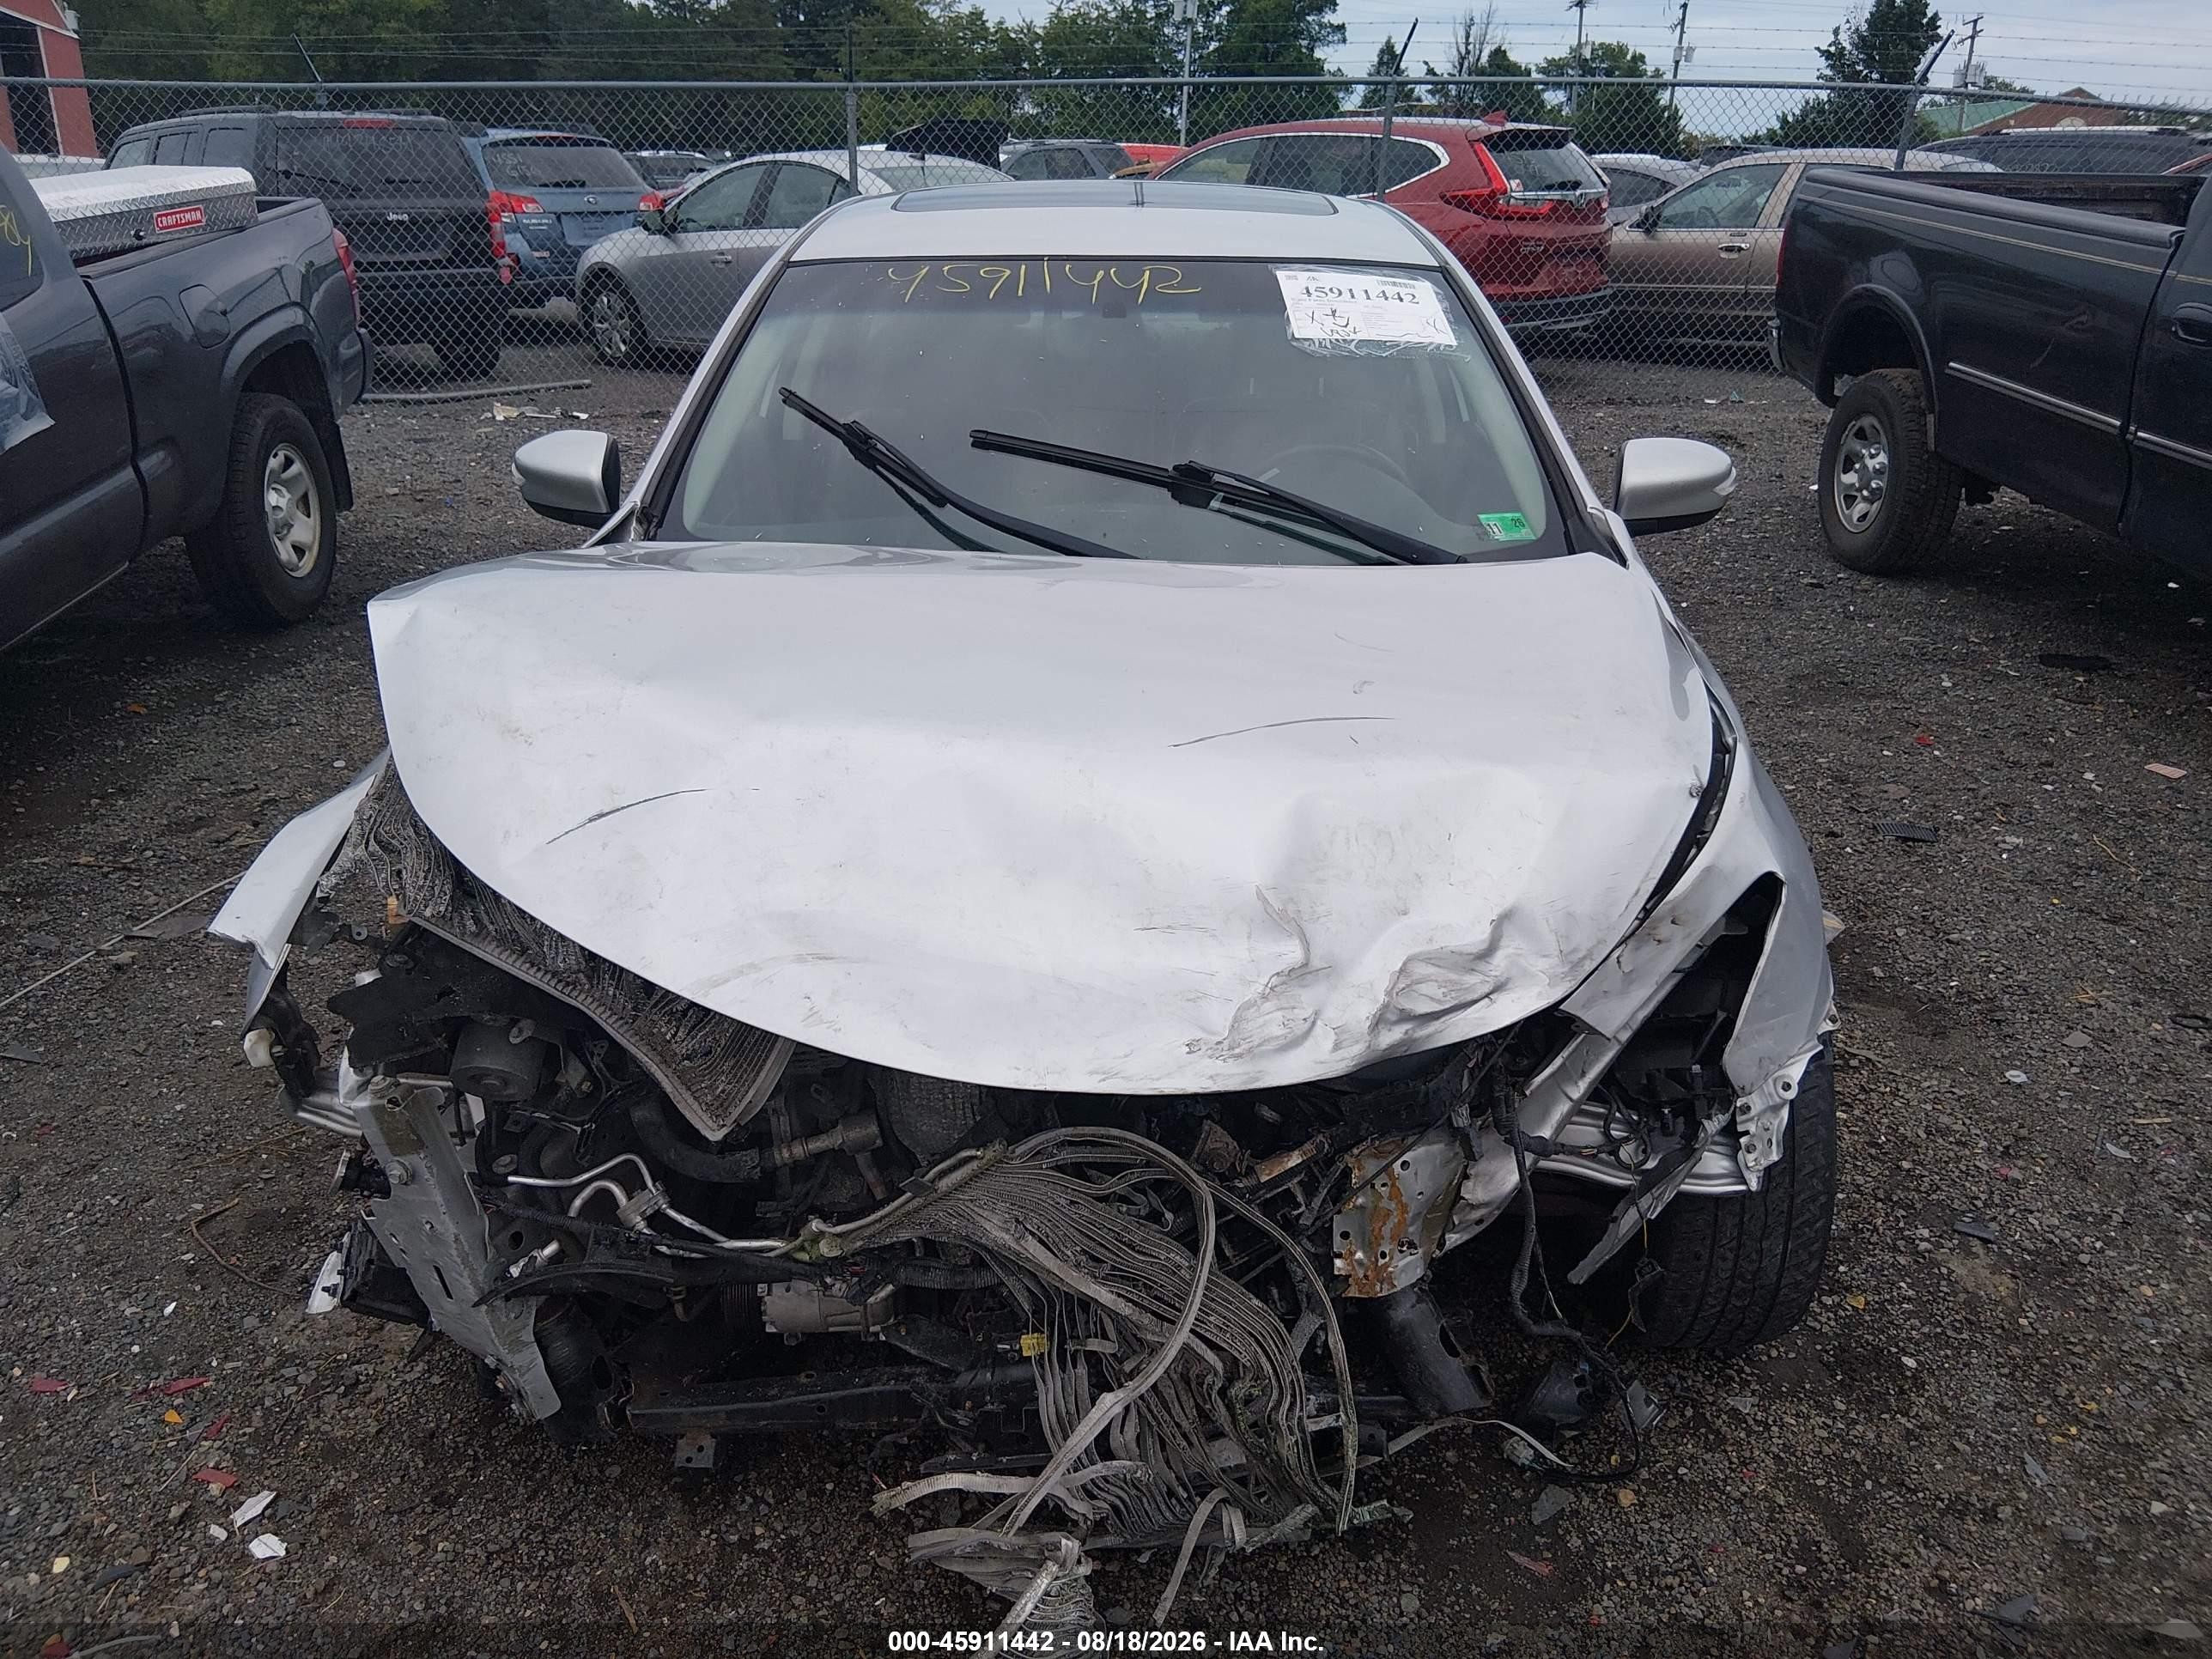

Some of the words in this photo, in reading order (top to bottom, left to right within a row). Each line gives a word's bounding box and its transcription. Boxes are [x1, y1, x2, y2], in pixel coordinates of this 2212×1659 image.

[157, 210, 202, 228] CRAFTSMAN
[888, 257, 1202, 305] 45911442
[1300, 285, 1420, 305] 45911442
[1486, 522, 1503, 535] 11
